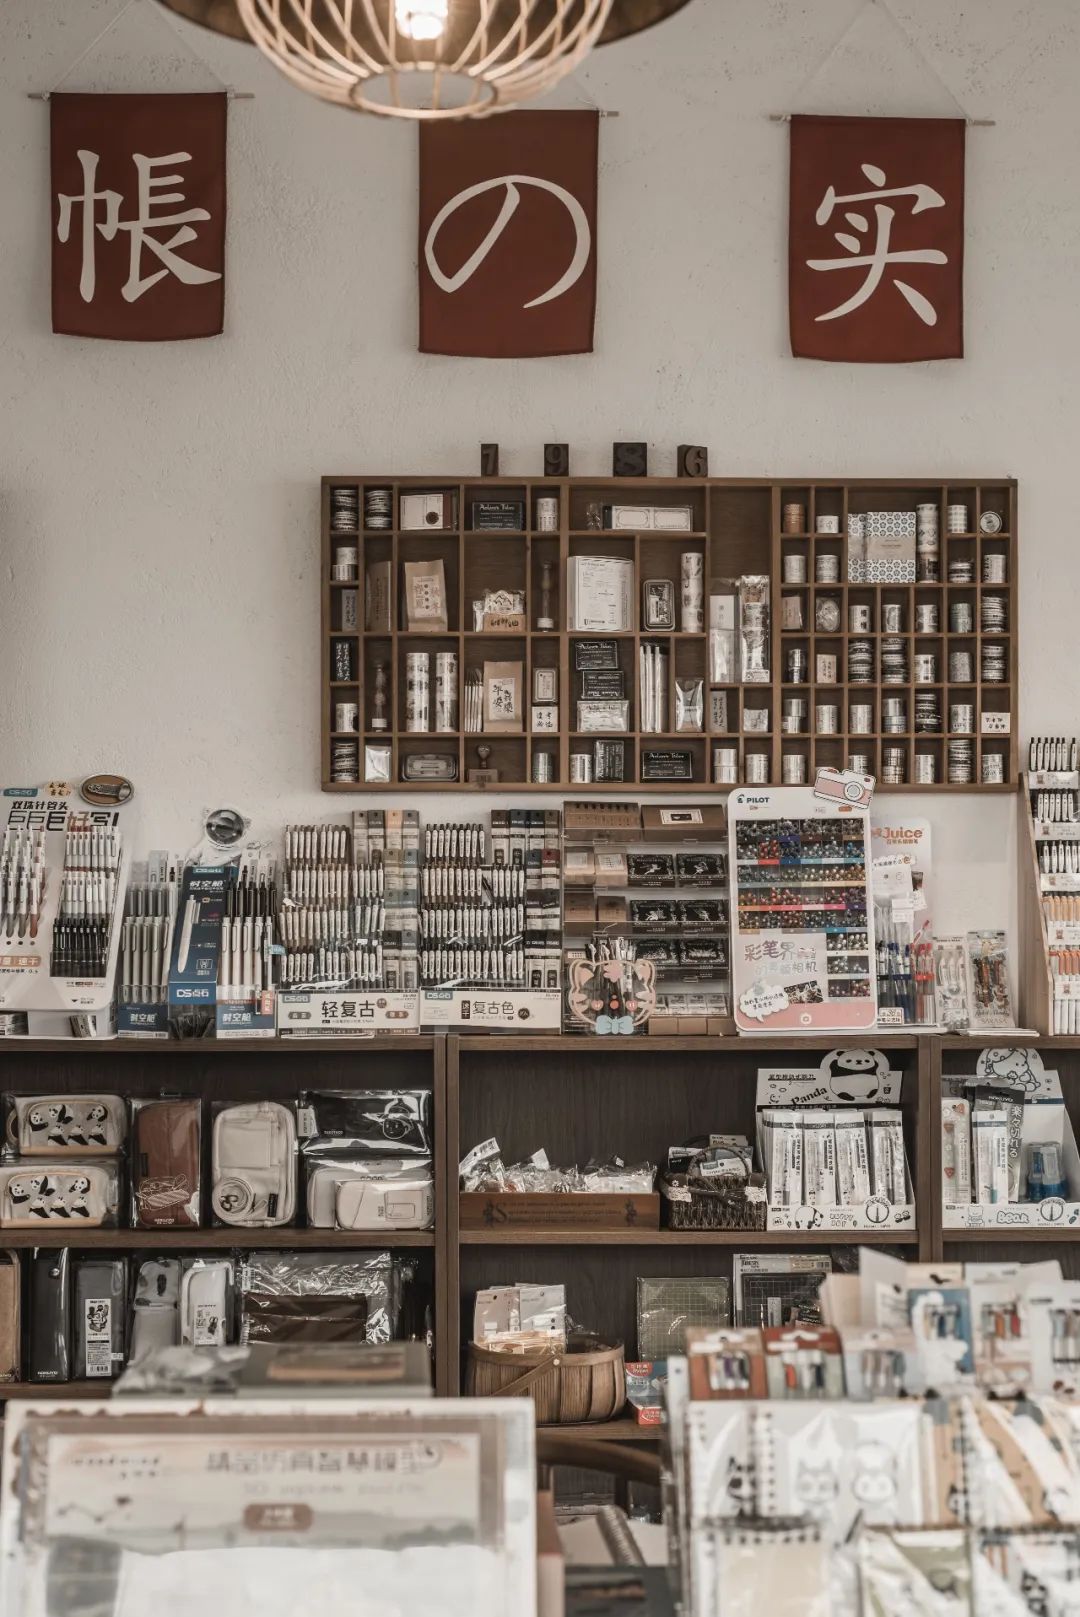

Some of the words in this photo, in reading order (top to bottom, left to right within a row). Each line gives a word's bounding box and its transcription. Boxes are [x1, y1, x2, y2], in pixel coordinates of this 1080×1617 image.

[57, 149, 222, 303] 帳
[425, 174, 591, 309] の
[806, 163, 949, 326] 实
[546, 446, 567, 475] 9
[882, 827, 923, 838] Juice
[321, 1000, 375, 1018] 轻复古
[472, 1001, 514, 1015] 复古色
[791, 1087, 828, 1111] Panda
